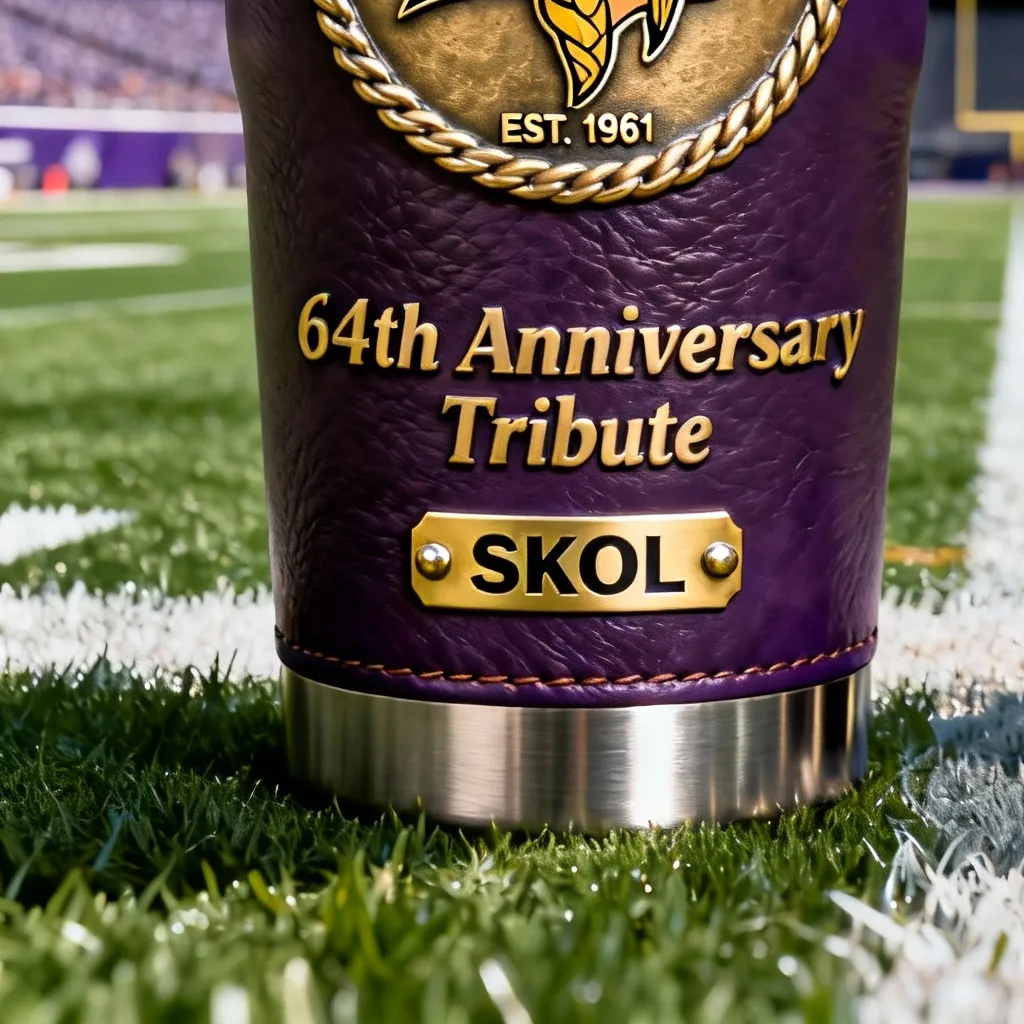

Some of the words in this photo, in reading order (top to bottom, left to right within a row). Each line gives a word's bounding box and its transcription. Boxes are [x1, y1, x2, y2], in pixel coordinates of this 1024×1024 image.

[501, 112, 572, 145] EST.
[582, 112, 653, 144] 1961
[297, 292, 441, 371] 64th
[454, 304, 866, 381] Anniversary
[440, 393, 714, 468] Tribute
[470, 534, 686, 596] SKOL
